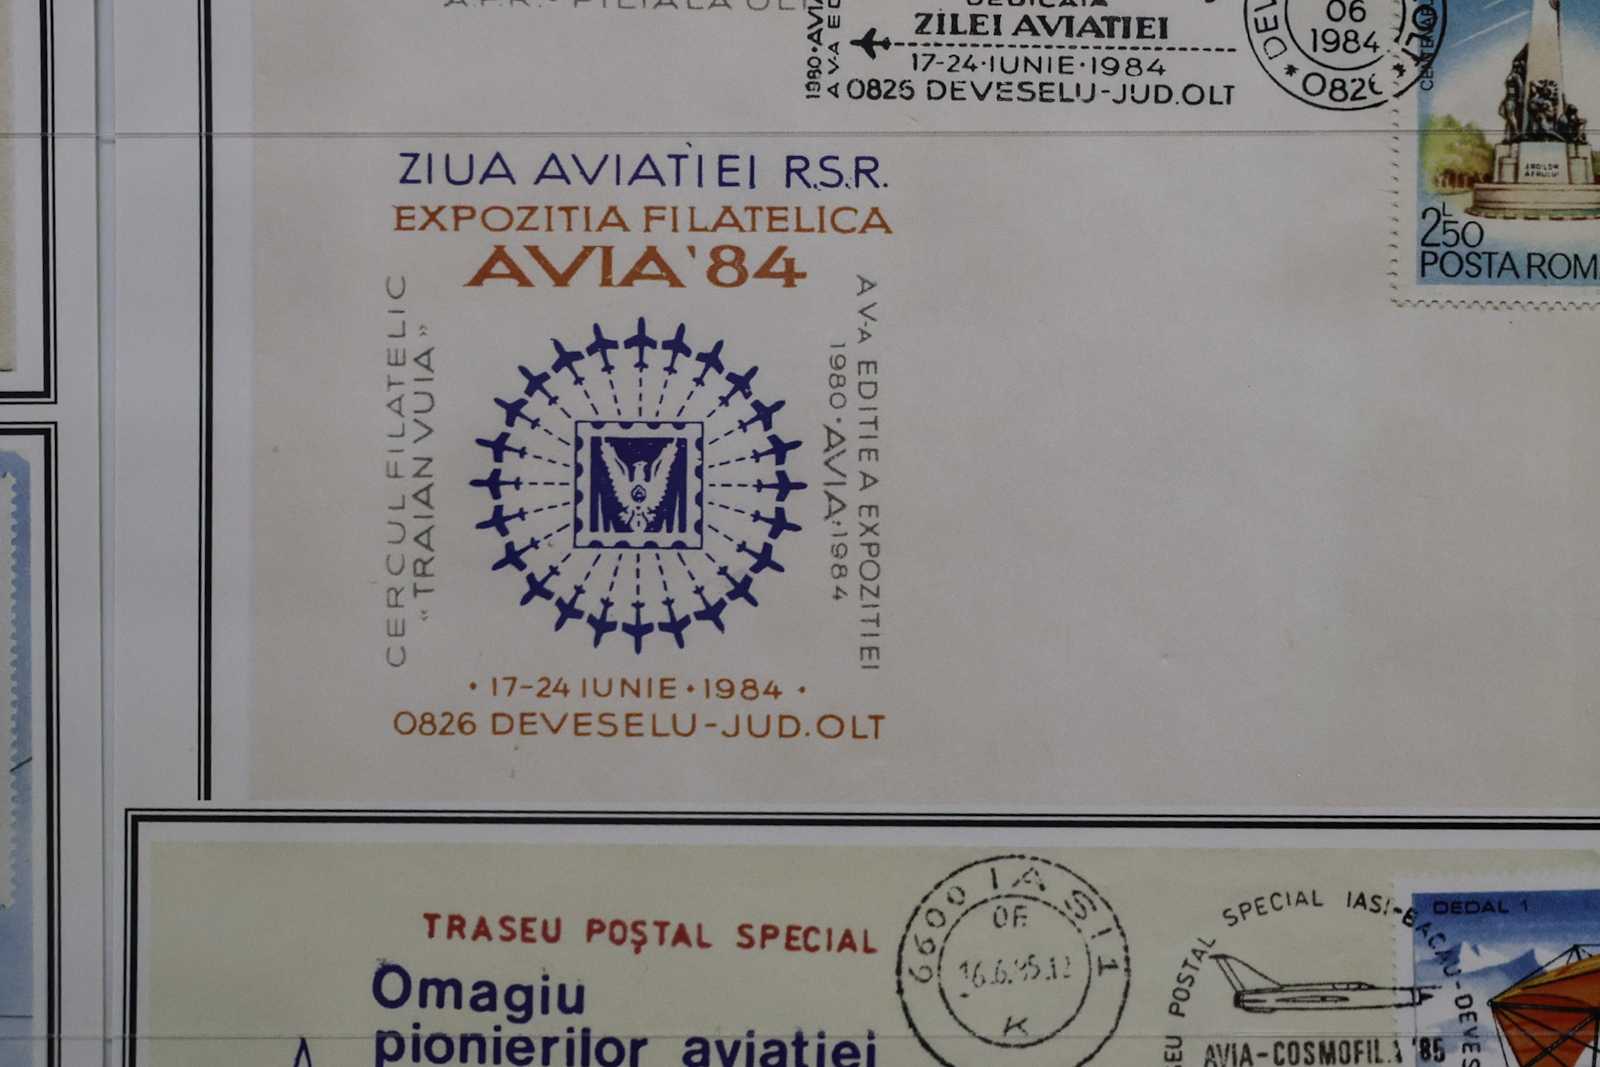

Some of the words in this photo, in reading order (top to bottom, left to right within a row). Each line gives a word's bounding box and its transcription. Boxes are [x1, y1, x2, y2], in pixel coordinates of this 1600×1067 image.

[914, 9, 1003, 35] ZILEI
[1011, 15, 1169, 40] AVIATIEI
[1311, 28, 1380, 54] 1984
[399, 152, 516, 185] ZIUA
[785, 154, 888, 190] R.S.R.
[393, 205, 631, 232] EXPOZITIA
[643, 205, 894, 234] FILATELICA
[462, 244, 807, 288] AVIA'84
[1420, 250, 1520, 279] POSTA
[386, 275, 406, 479] FILATELIC
[857, 360, 879, 463] EDITIE
[859, 470, 880, 492] A
[386, 493, 406, 668] CERCUL
[858, 504, 881, 670] EXPOZITIEI
[491, 676, 570, 698] 17-24
[393, 711, 478, 736] 0826
[909, 885, 966, 983] 6600
[990, 867, 1113, 939] IASI
[1222, 889, 1324, 928] SPECIAL
[1433, 900, 1511, 916] DEDAL
[1519, 899, 1528, 914] 1
[422, 912, 562, 944] TRASEU
[737, 922, 878, 955] SPECIAL
[372, 963, 586, 1024] Omagiu
[1169, 937, 1217, 1018] POSTAL
[375, 1022, 647, 1067] pionierilor
[1003, 1016, 1029, 1036] K
[1164, 1036, 1184, 1067] EU
